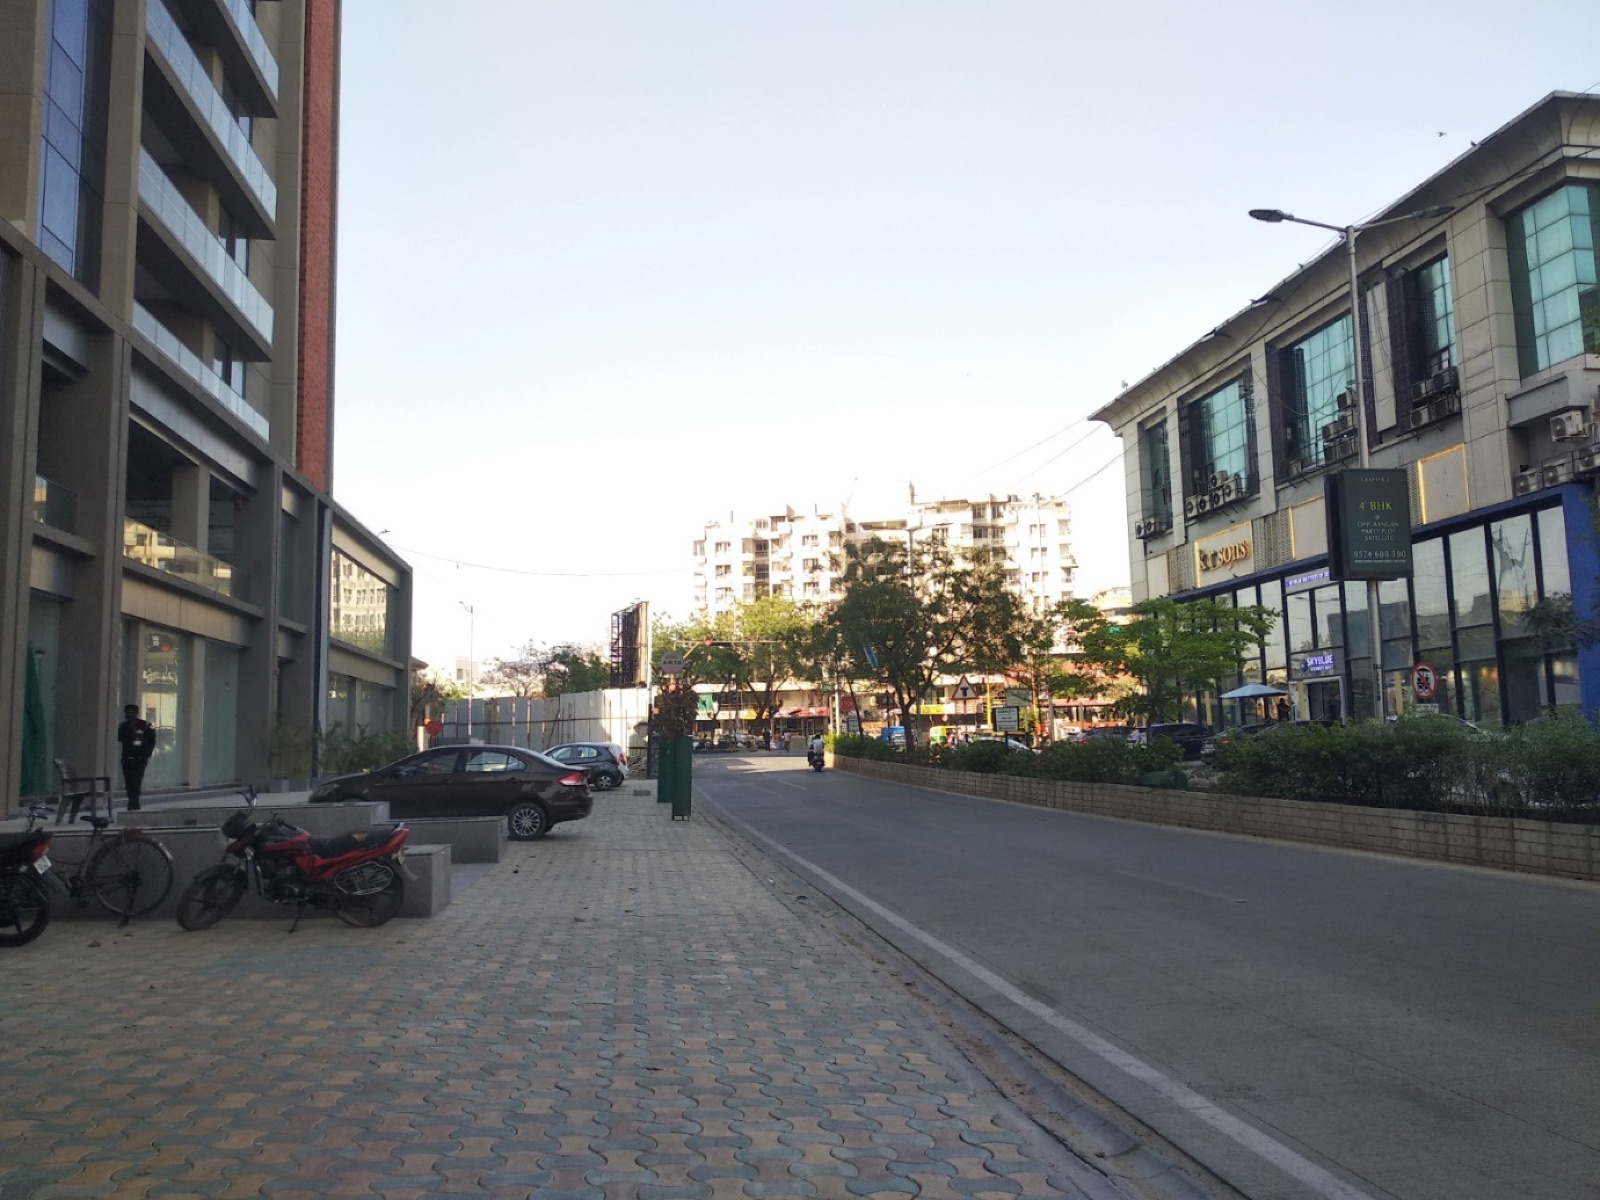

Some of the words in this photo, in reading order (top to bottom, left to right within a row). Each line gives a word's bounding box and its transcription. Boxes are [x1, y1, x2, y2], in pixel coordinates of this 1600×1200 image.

[1359, 501, 1365, 510] 4
[1370, 501, 1392, 510] BHK
[1306, 654, 1333, 666] SKYBLUE
